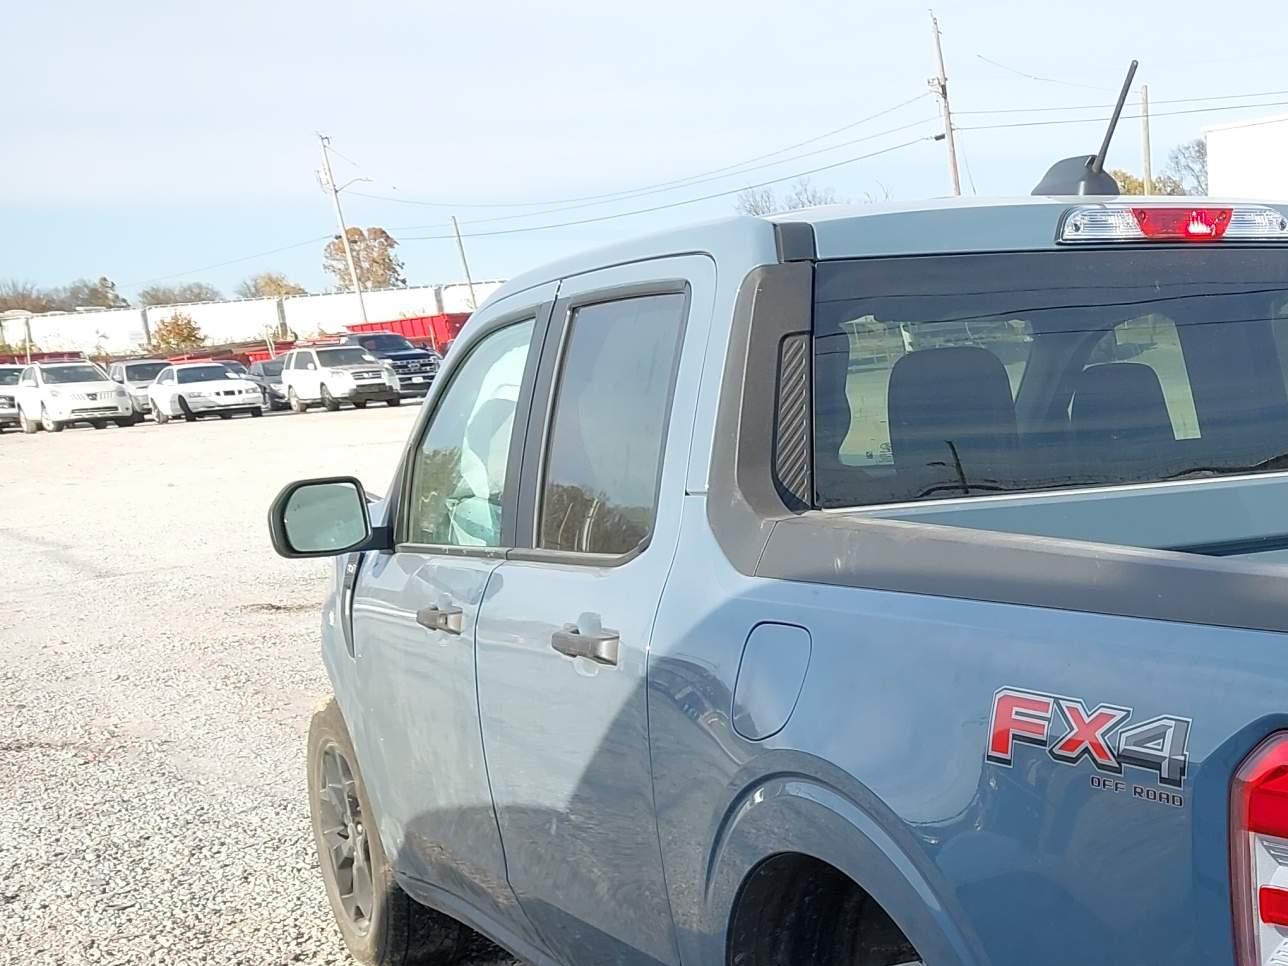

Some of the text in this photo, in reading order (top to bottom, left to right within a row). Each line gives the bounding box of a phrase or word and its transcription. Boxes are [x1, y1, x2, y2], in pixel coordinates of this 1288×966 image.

[985, 685, 1192, 789] FX4
[1090, 775, 1184, 808] OFF ROAD
